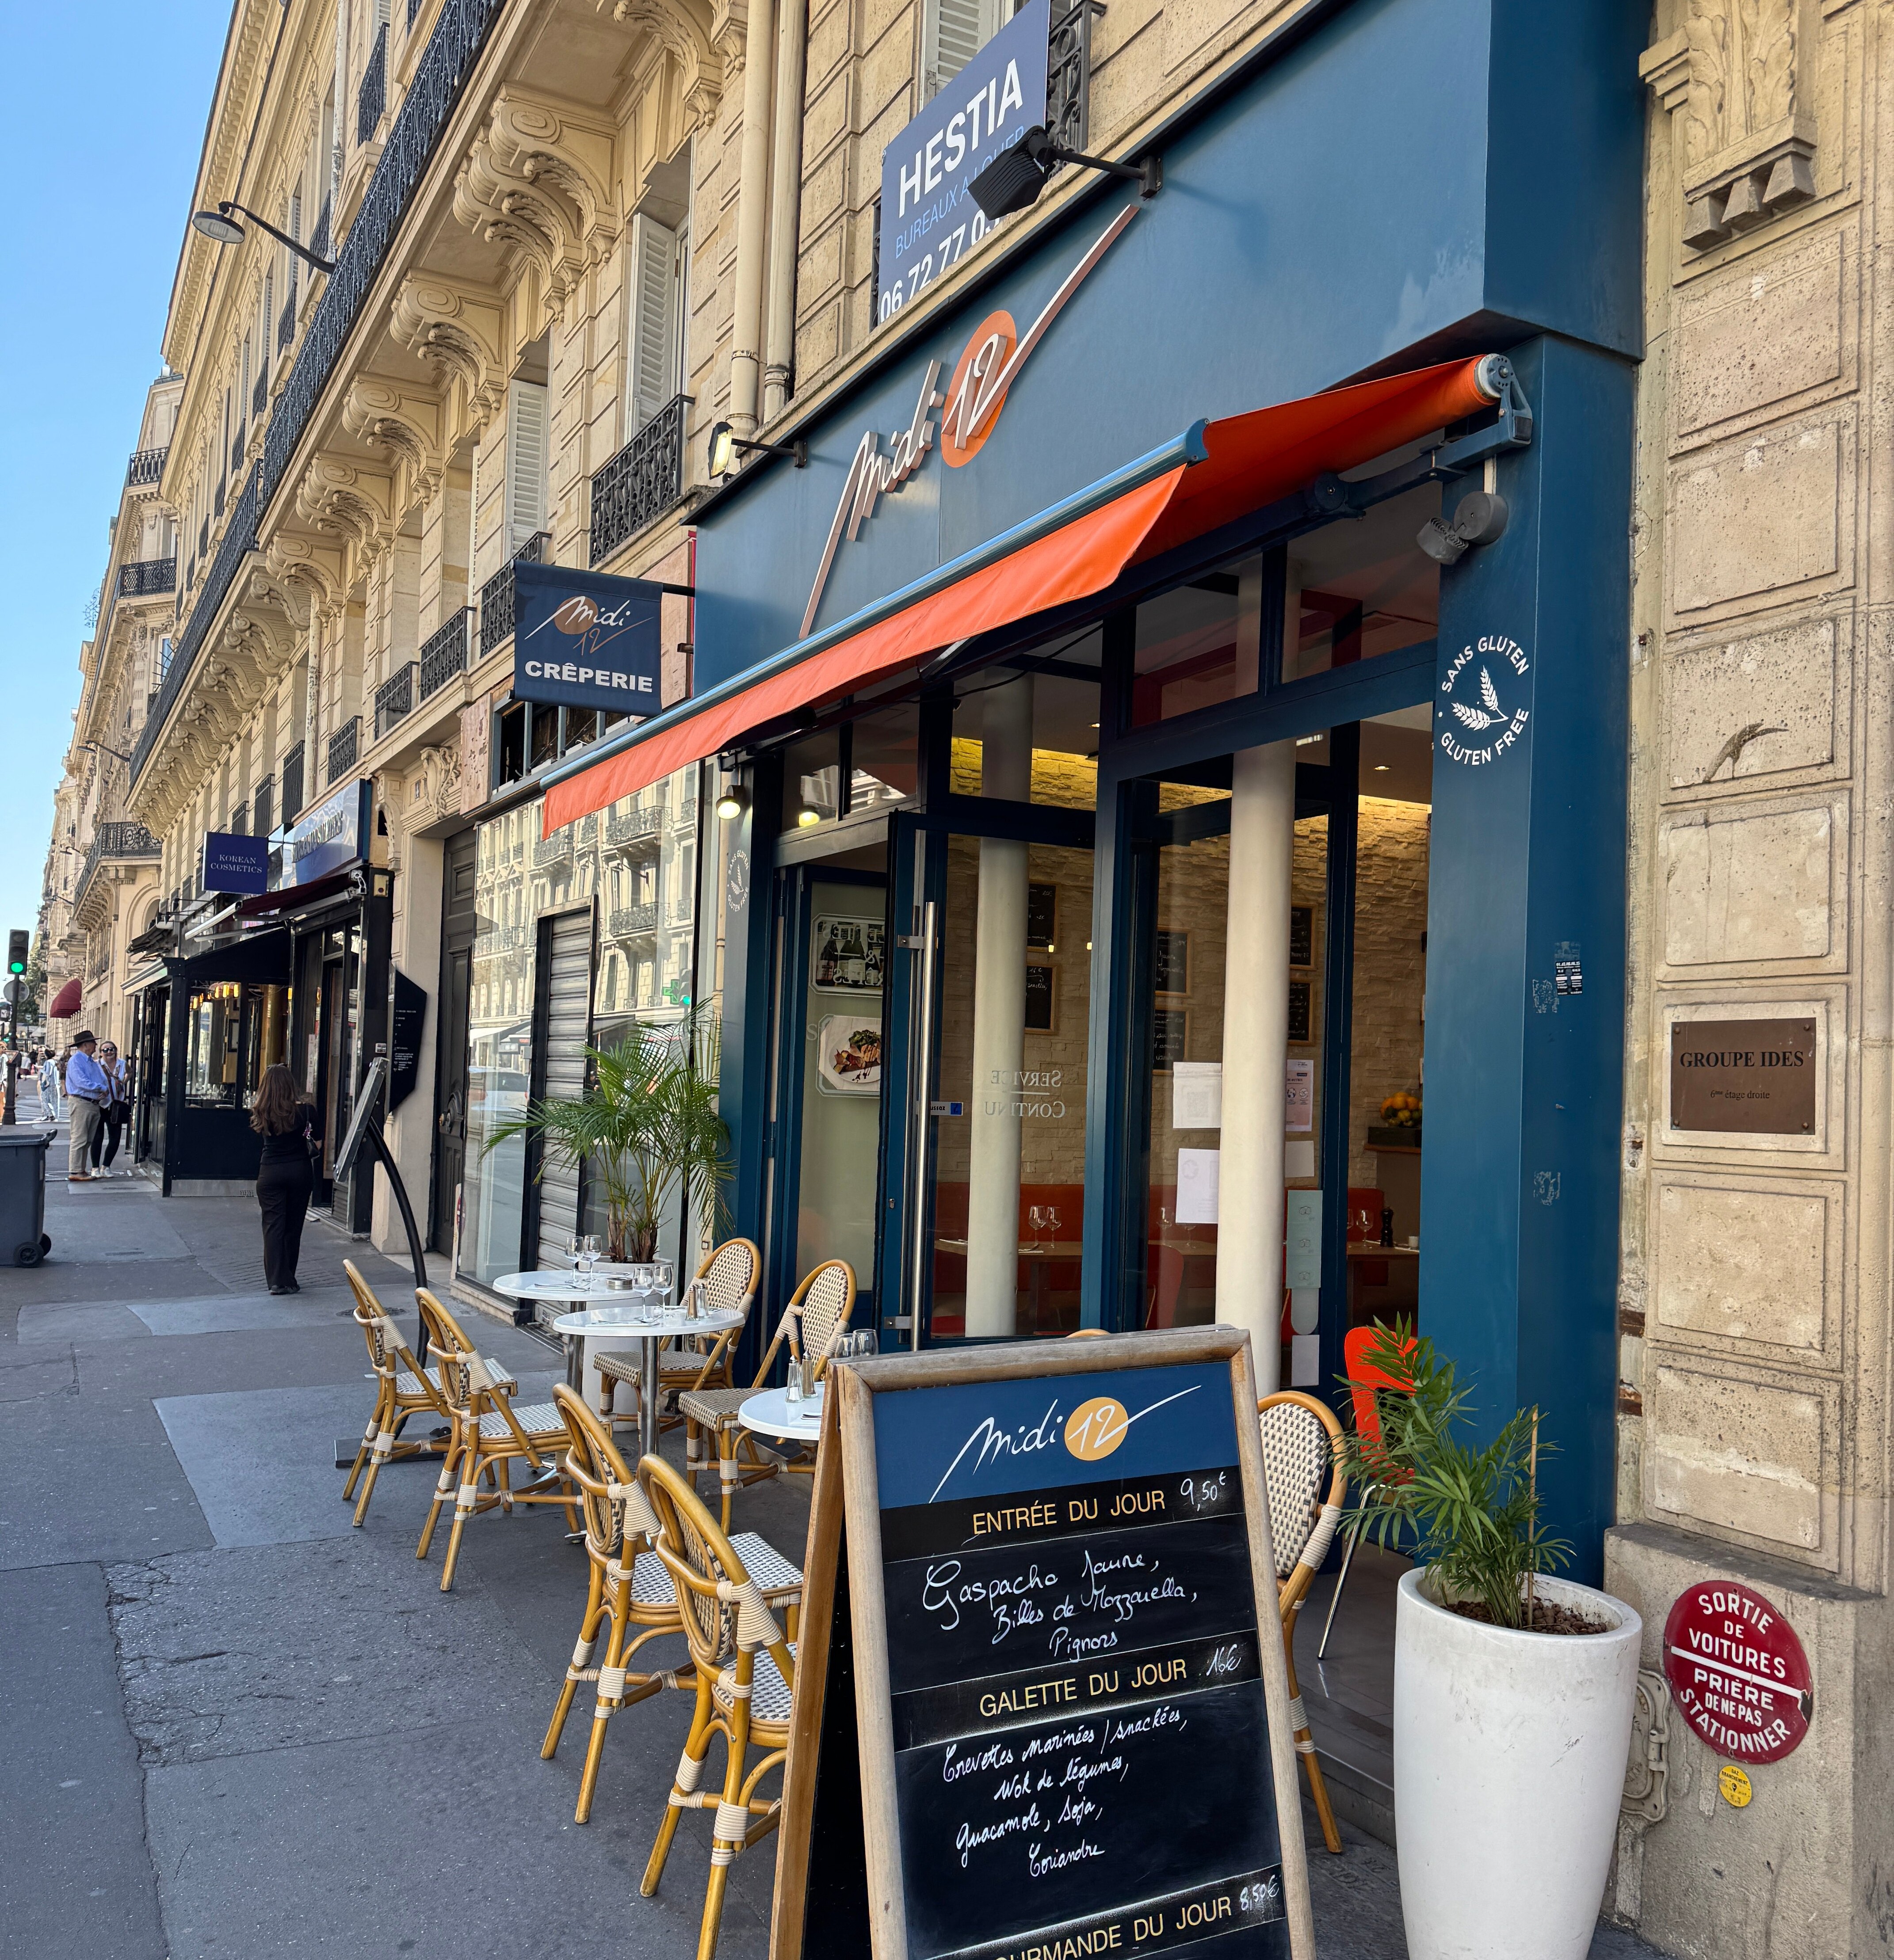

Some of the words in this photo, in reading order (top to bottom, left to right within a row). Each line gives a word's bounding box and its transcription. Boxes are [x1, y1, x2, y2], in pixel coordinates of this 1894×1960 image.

[898, 58, 1023, 218] HESTIA
[896, 184, 958, 259] BUREAUX
[960, 175, 970, 203] A
[880, 280, 902, 323] 06
[908, 254, 932, 300] 72
[939, 223, 966, 274] 77
[971, 209, 1000, 246] 0
[573, 617, 654, 656] 12
[525, 661, 653, 692] CRÊPERIE
[1442, 645, 1474, 693] SANS
[1478, 636, 1529, 675] GLUTEN
[1441, 732, 1491, 765] GLUTEN
[1495, 708, 1529, 755] FREE
[210, 862, 262, 873] COSMETICS
[219, 854, 256, 864] KOREAN
[1680, 1052, 1754, 1067] GROUPE
[1760, 1051, 1804, 1067] IDES
[1725, 1090, 1745, 1100] étage
[974, 1500, 1057, 1535] ENTRÉE
[1070, 1499, 1098, 1522] DU
[1110, 1490, 1165, 1517] JOUR
[922, 1560, 1058, 1630] Gaspacho
[1053, 1595, 1081, 1621] de
[1698, 1592, 1773, 1634] SORTIE
[1724, 1620, 1744, 1639] DE
[1689, 1628, 1785, 1678] VOITURES
[980, 1678, 1077, 1717] GALETTE
[1089, 1673, 1119, 1696] DU
[1132, 1660, 1187, 1688] JOUR
[1680, 1689, 1791, 1754] STATIONNER
[1705, 1692, 1719, 1712] DE
[1721, 1697, 1736, 1718] NE
[1738, 1704, 1762, 1727] PAS
[943, 1743, 1013, 1782] Crevettes
[1037, 1769, 1053, 1792] de
[1029, 1839, 1105, 1877] Coriandre
[1134, 1917, 1163, 1942] DU
[1176, 1896, 1231, 1928] JOUR
